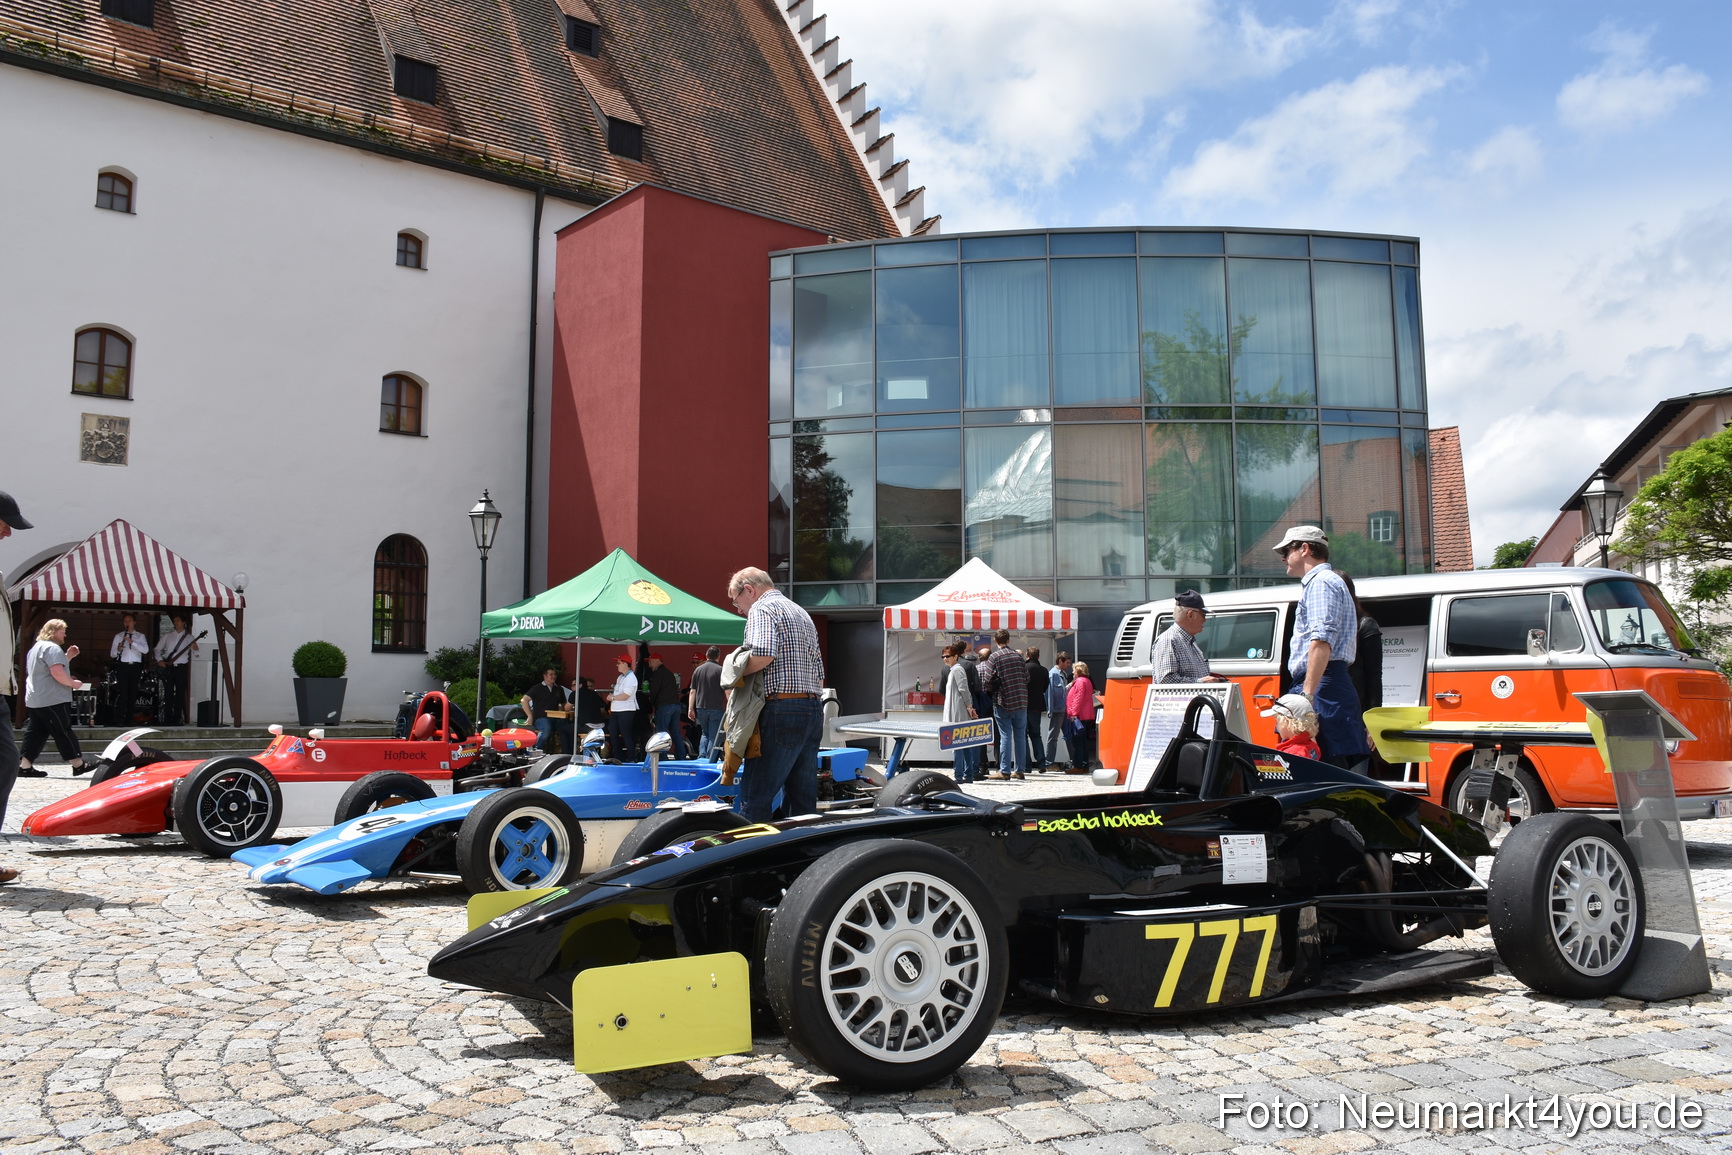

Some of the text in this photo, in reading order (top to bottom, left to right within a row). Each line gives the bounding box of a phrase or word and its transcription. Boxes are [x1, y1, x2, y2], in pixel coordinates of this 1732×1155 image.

[937, 589, 1012, 602] Lehmeier's
[520, 616, 545, 630] DEKRA
[658, 619, 700, 635] DEKRA
[952, 723, 991, 740] PIRTEK
[384, 750, 427, 760] Hofbeck
[917, 776, 934, 790] AVON
[1038, 809, 1163, 833] sascha hofbeck
[897, 954, 919, 980] BBS
[1145, 914, 1277, 1008] 777
